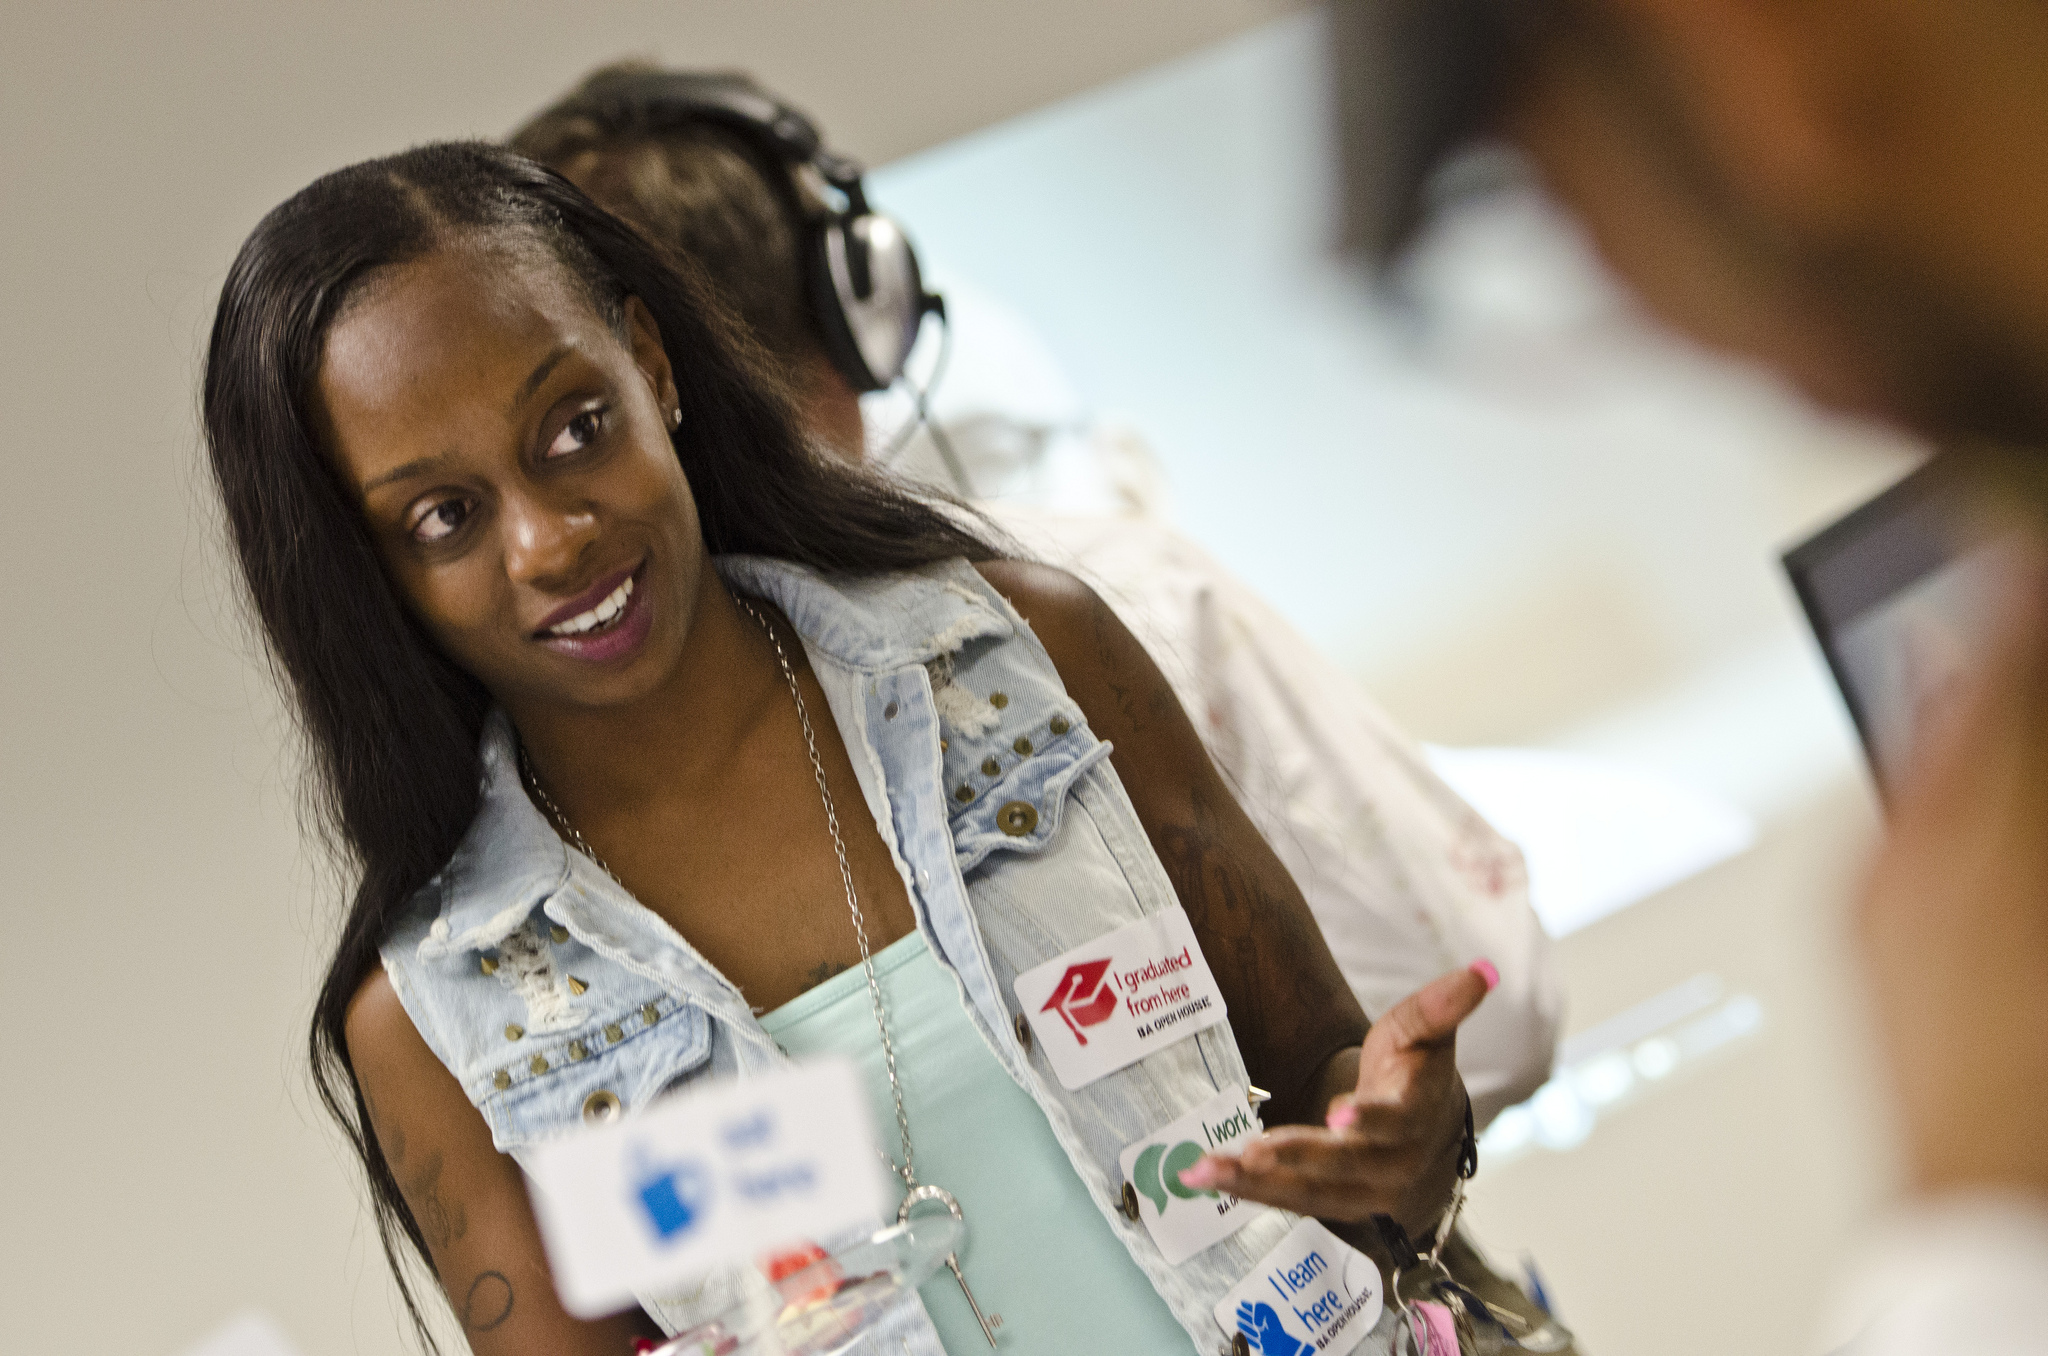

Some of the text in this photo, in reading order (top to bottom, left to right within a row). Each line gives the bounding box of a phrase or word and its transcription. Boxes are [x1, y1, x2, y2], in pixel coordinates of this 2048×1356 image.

[1114, 945, 1193, 993] I graduated
[1126, 983, 1190, 1018] from here
[1154, 1010, 1178, 1031] OPEN
[1201, 1105, 1252, 1148] I work
[1268, 1250, 1328, 1302] I learn
[1292, 1289, 1343, 1334] here
